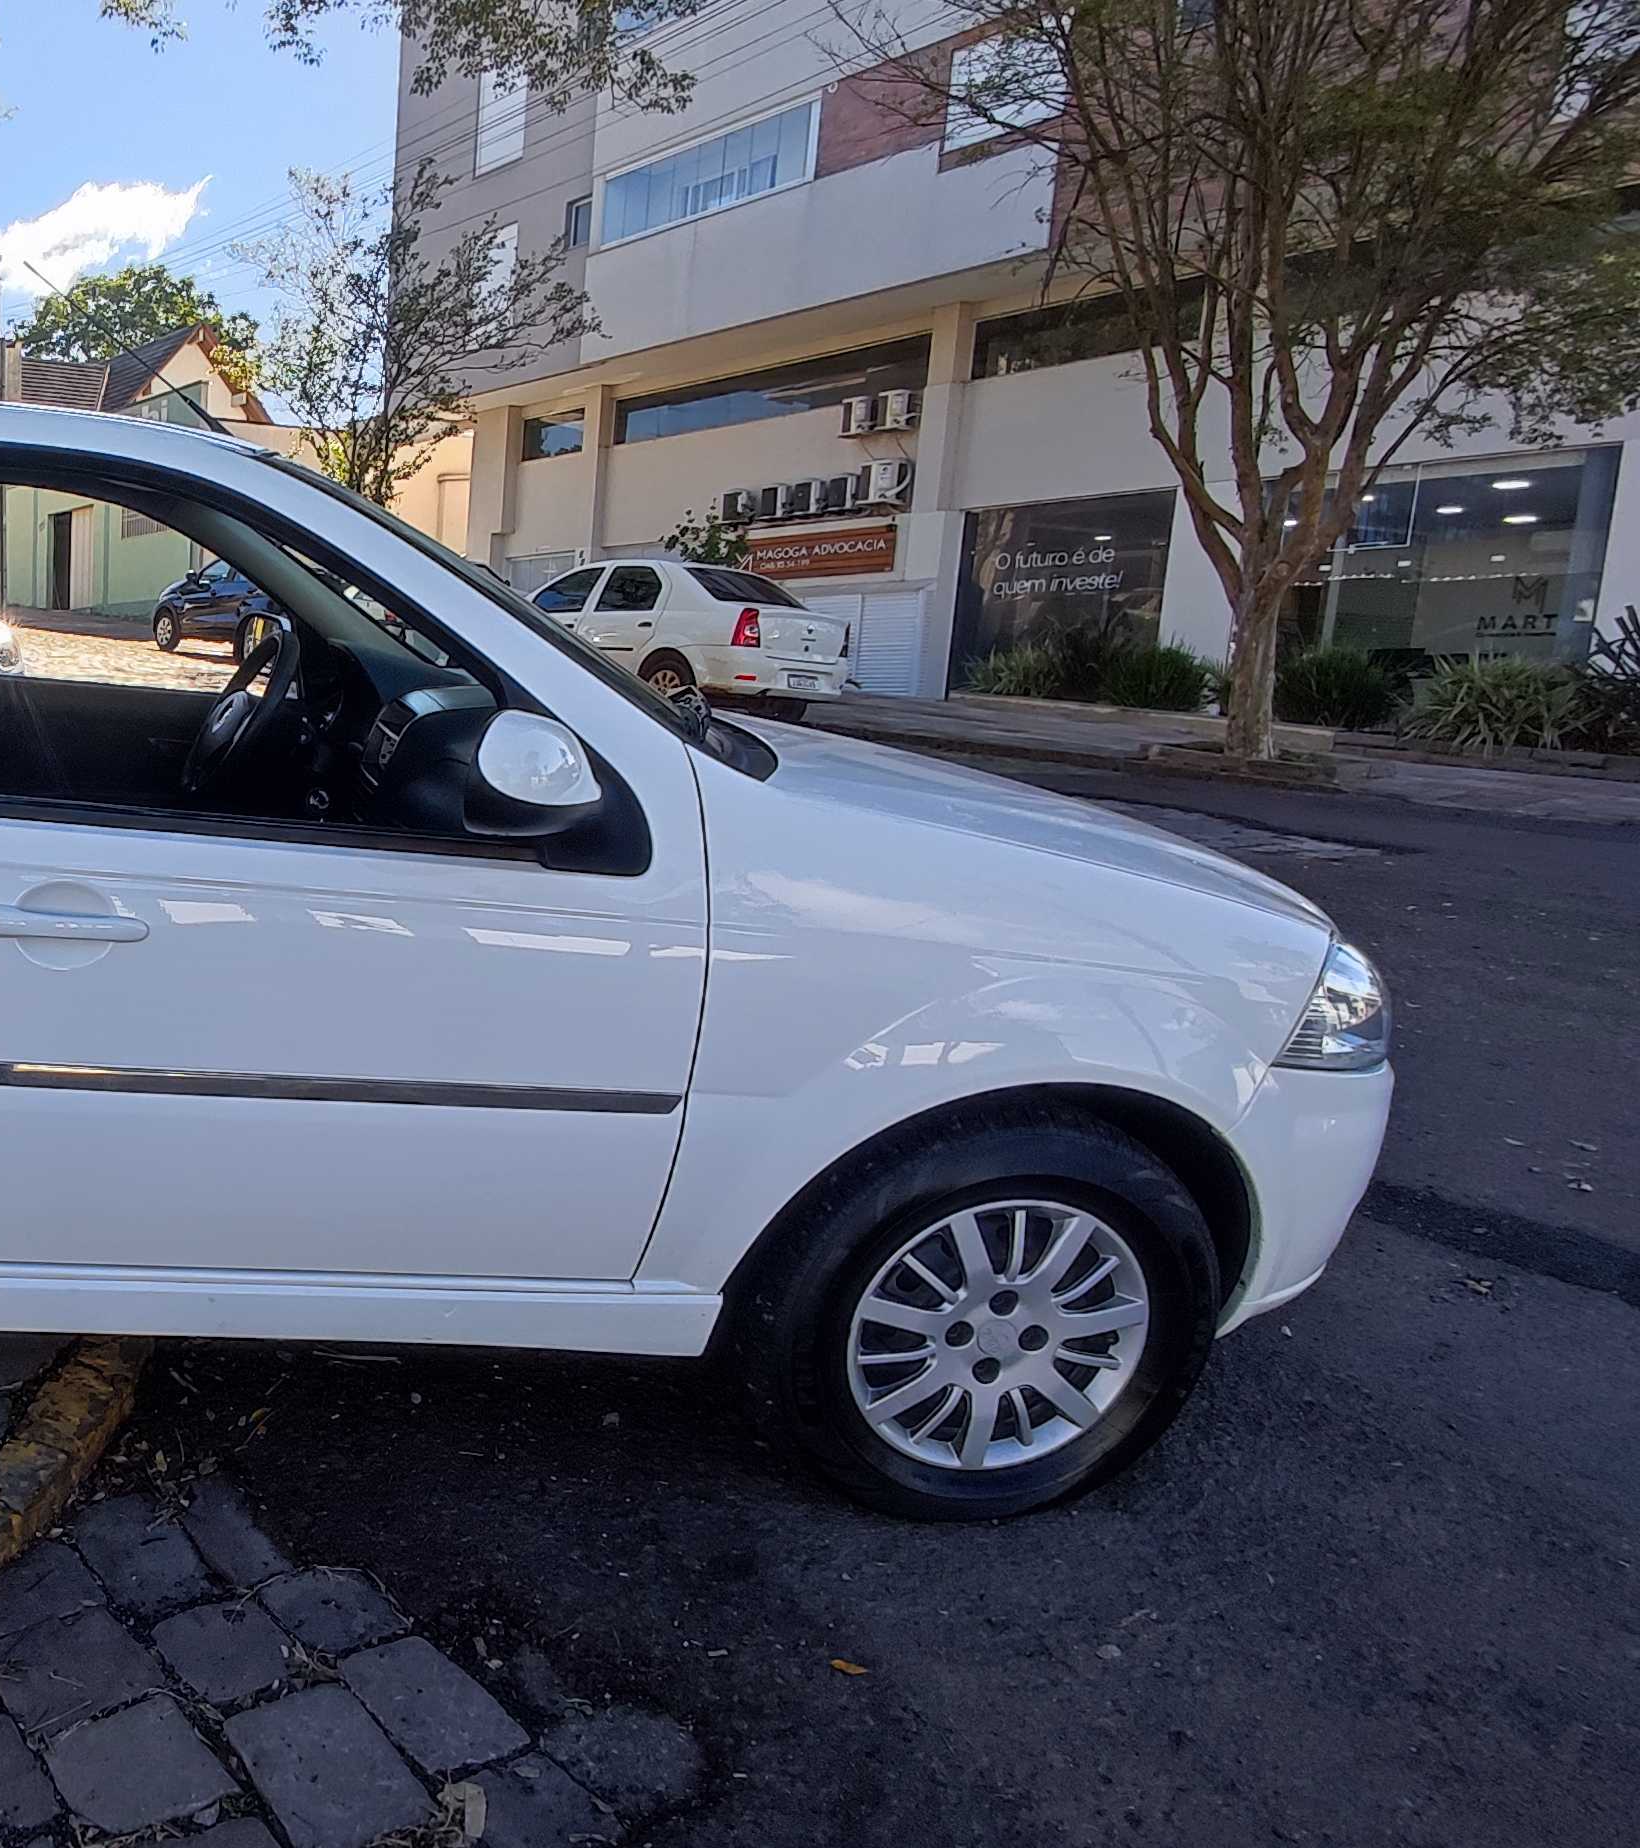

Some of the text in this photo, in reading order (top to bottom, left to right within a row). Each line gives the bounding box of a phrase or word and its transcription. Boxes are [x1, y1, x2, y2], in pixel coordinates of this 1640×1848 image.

[756, 538, 887, 560] MAGOGA ADVOCACIA
[995, 545, 1116, 570] O futuro é de
[993, 570, 1124, 598] quem investe!
[1476, 613, 1559, 630] MART
